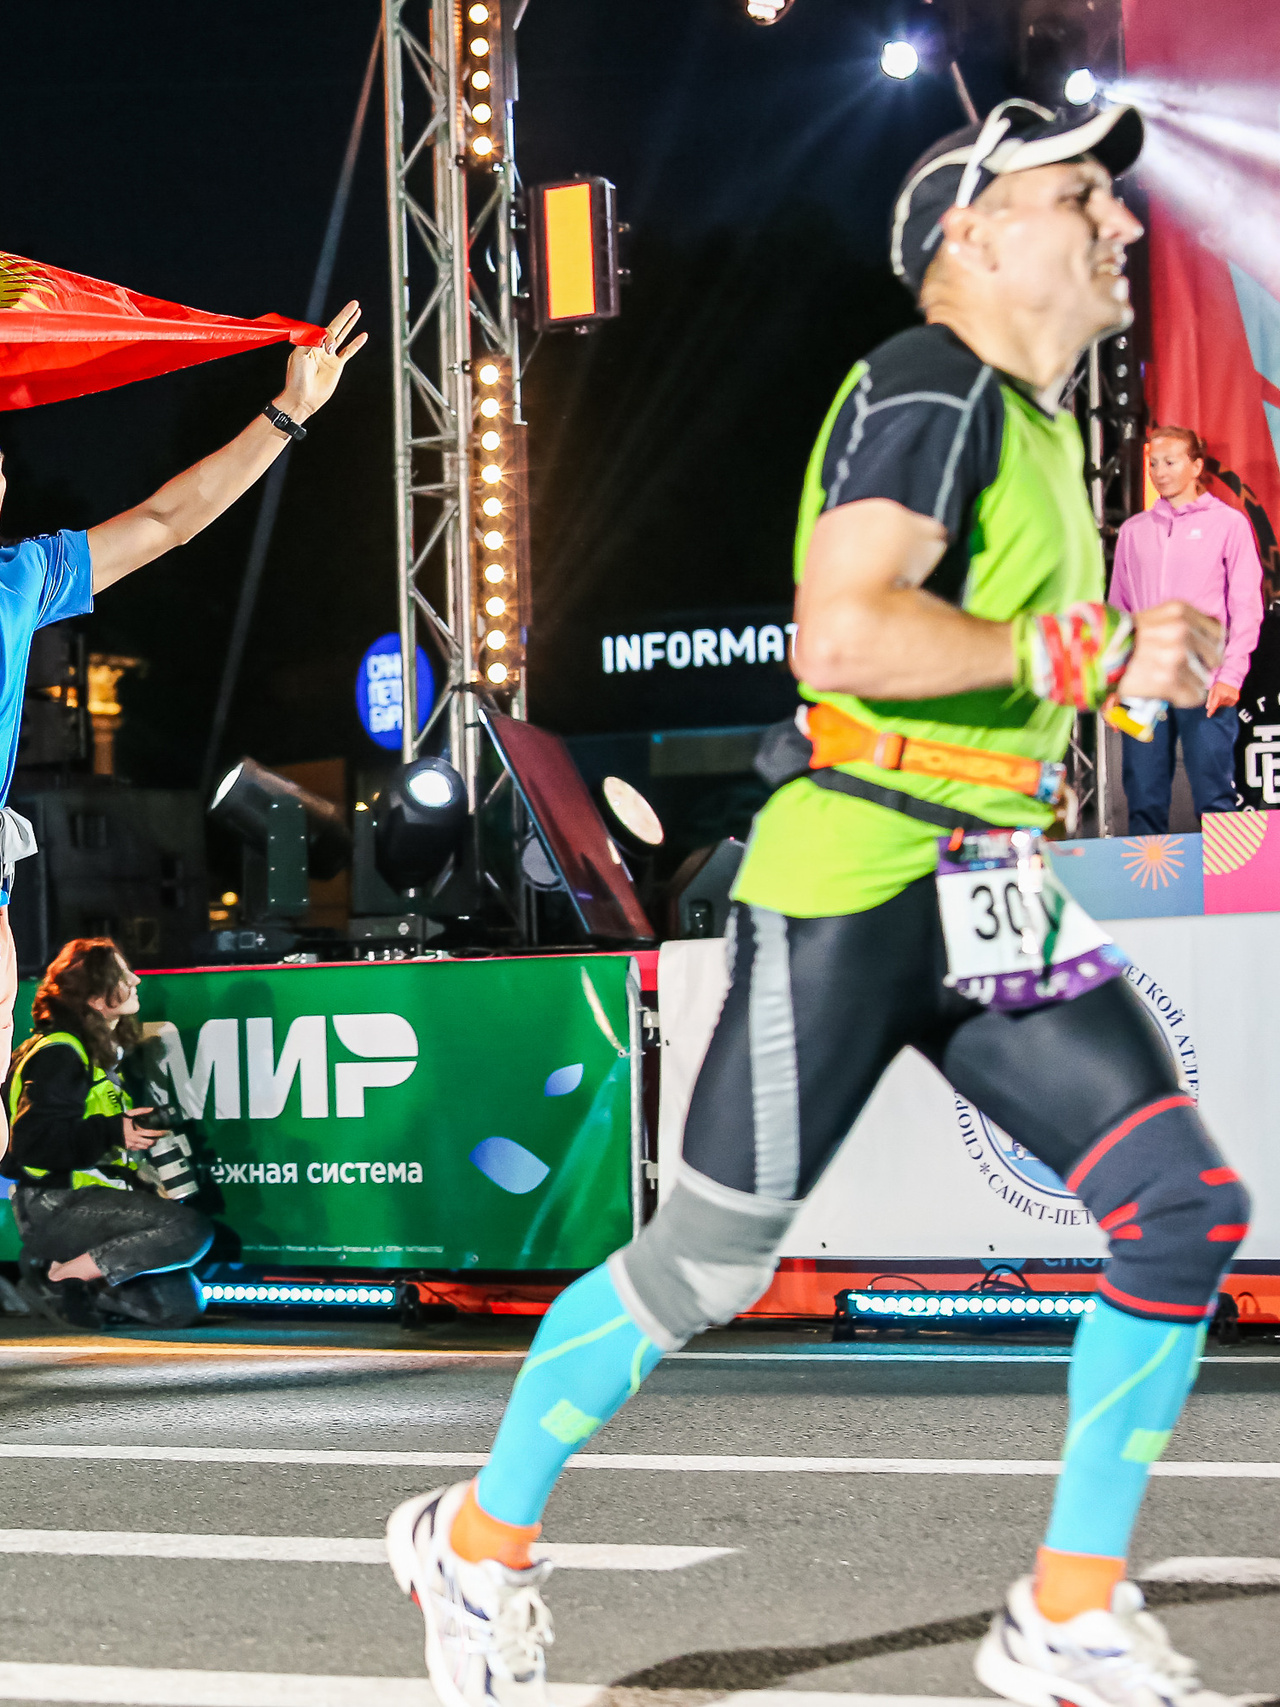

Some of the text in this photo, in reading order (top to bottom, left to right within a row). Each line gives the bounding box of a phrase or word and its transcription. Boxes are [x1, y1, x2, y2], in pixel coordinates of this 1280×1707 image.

[1125, 964, 1186, 1028] ЕГКОЙ
[144, 1013, 419, 1120] МИР
[210, 1158, 423, 1185] ёжная система
